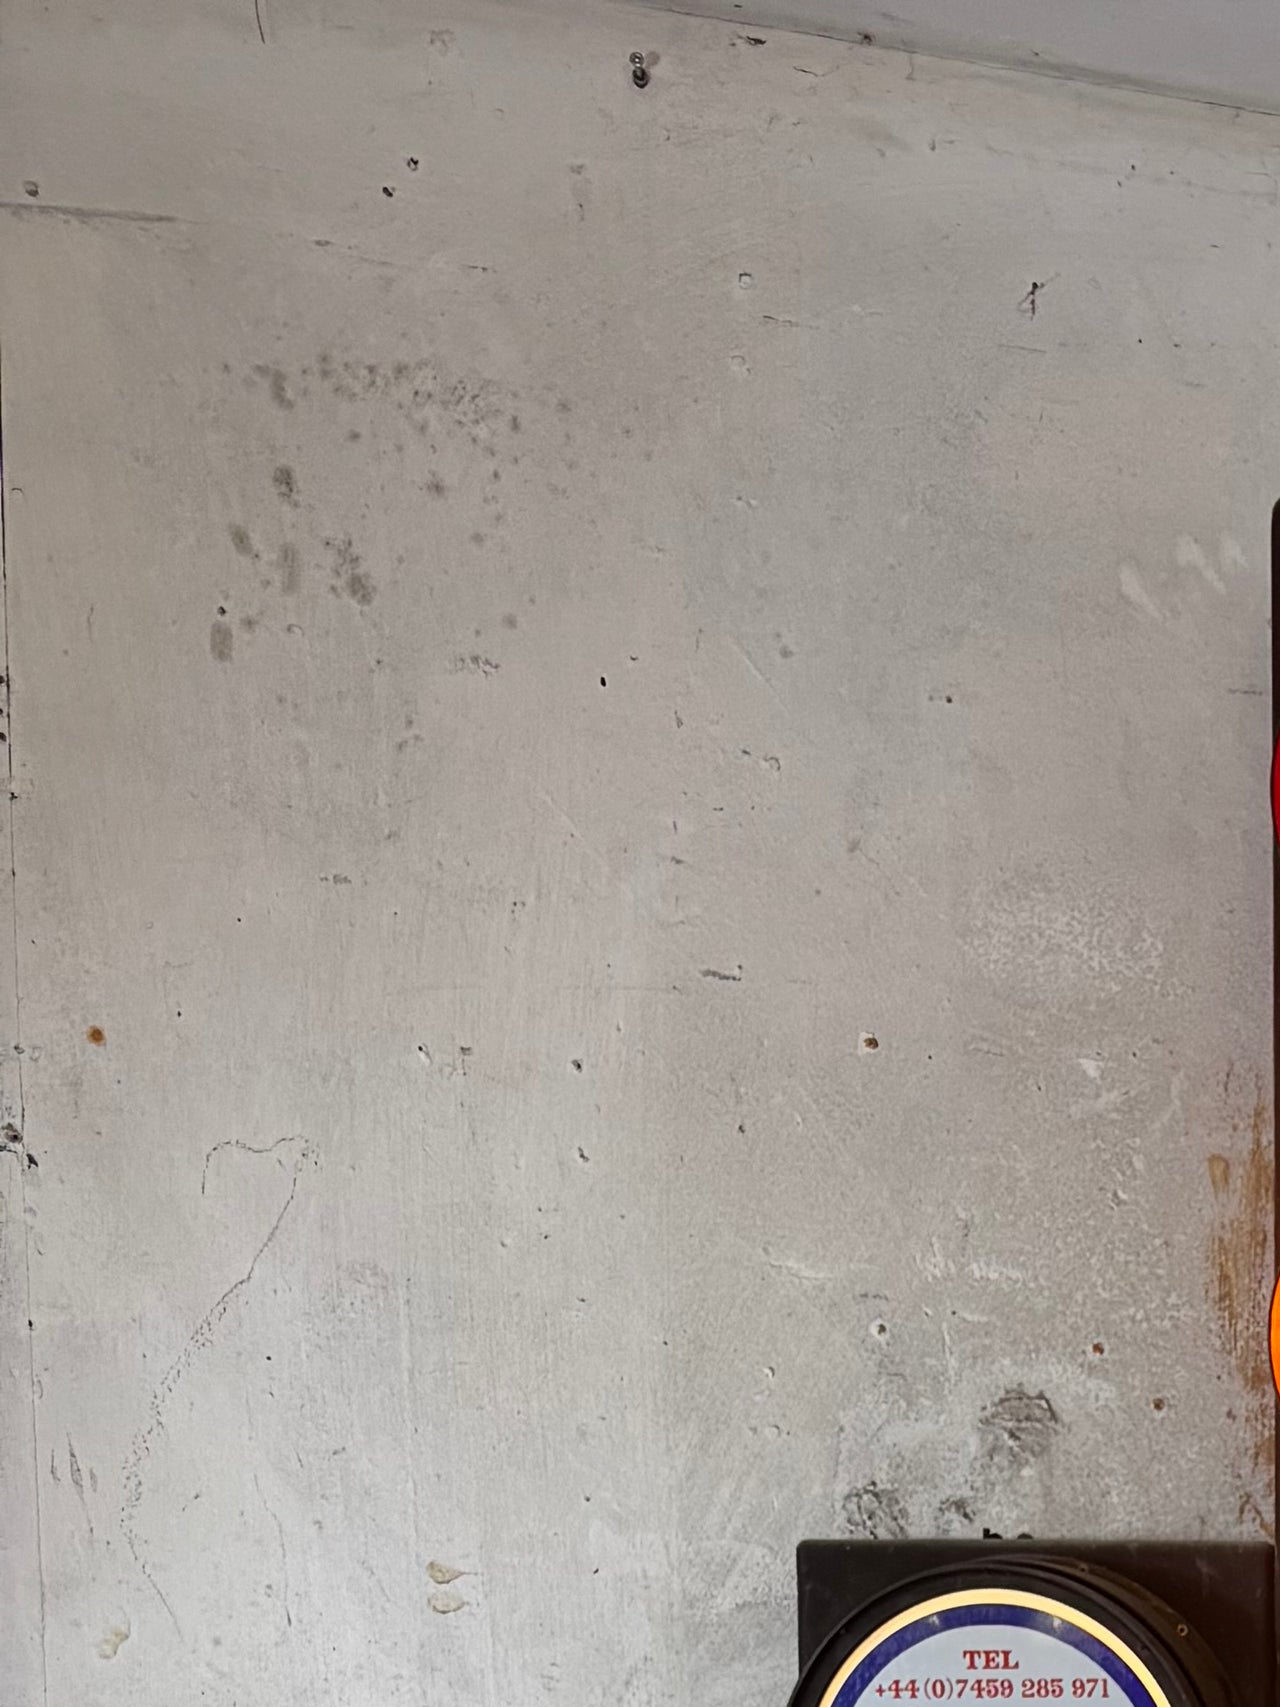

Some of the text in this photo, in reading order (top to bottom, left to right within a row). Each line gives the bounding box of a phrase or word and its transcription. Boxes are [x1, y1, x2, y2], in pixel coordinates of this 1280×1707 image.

[962, 1649, 1019, 1671] TEL
[875, 1678, 1110, 1700] +44(0)7459 285 971
